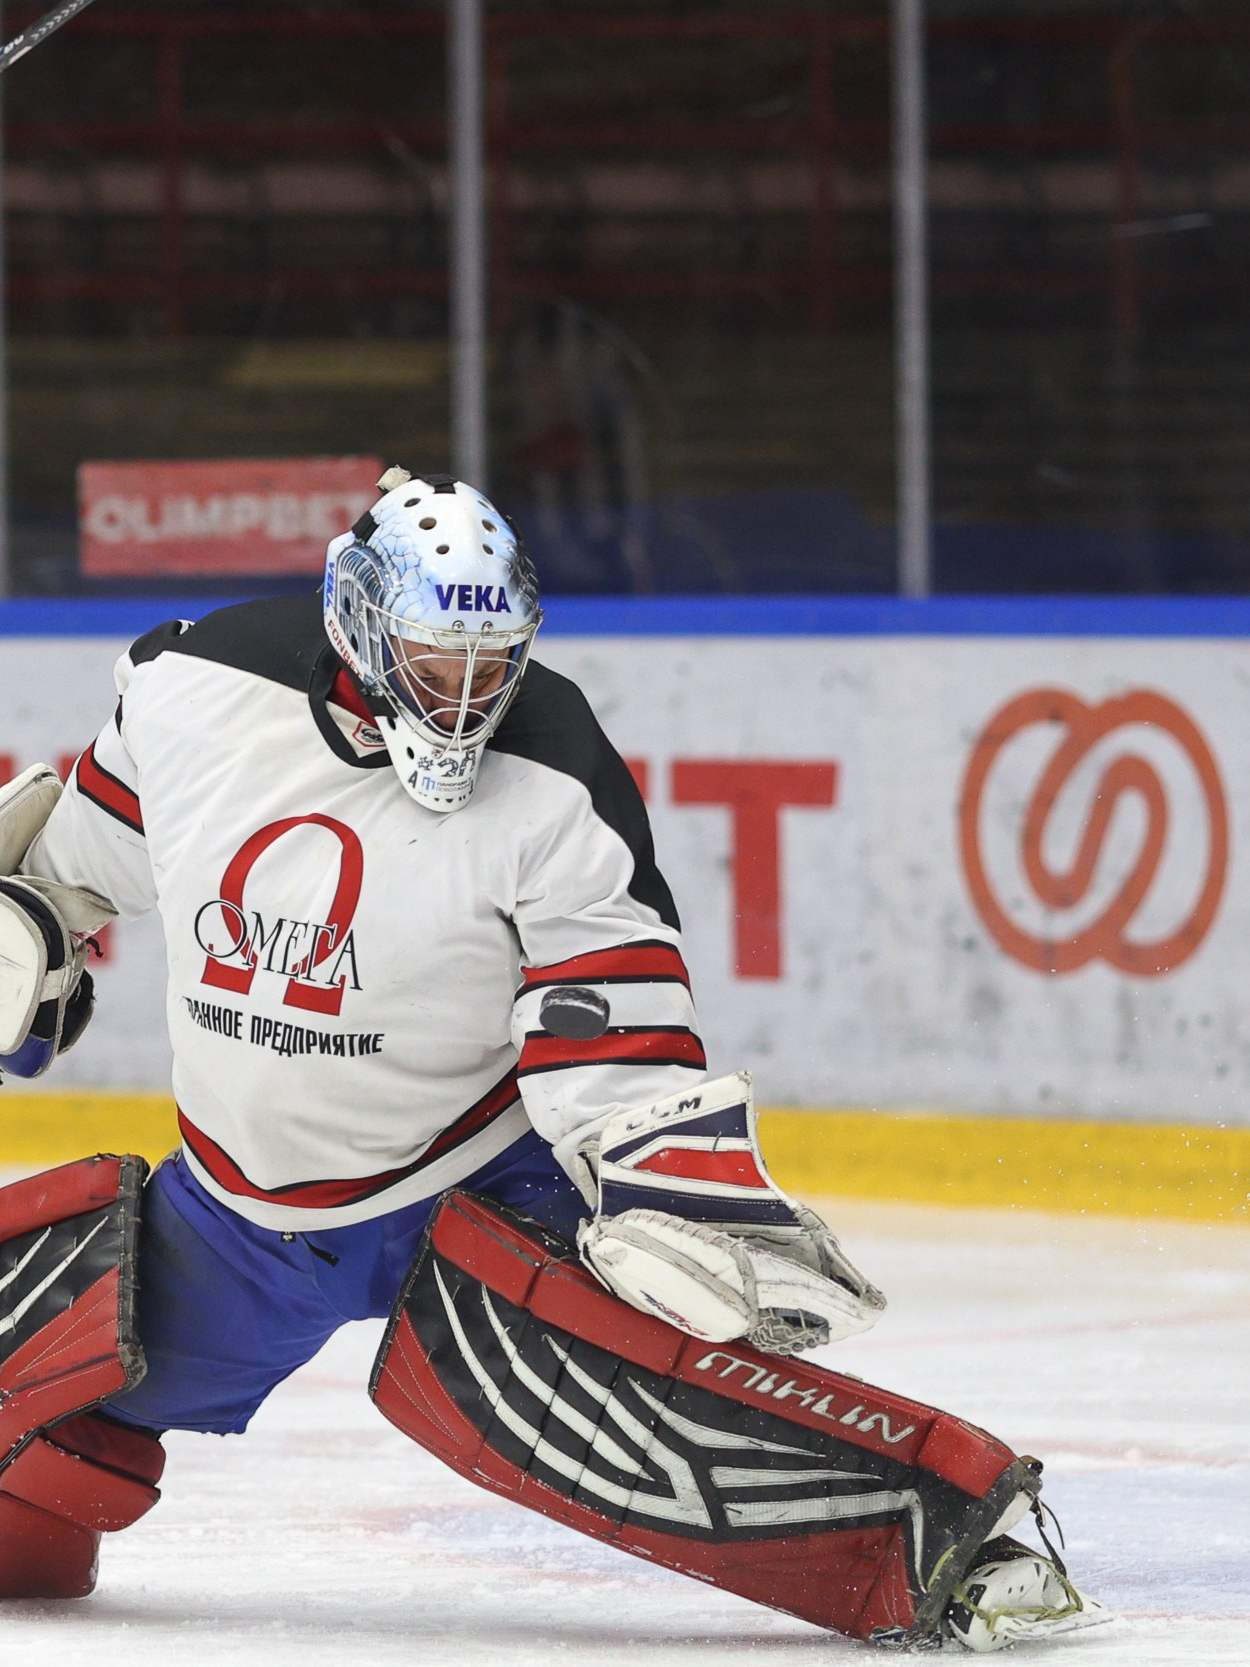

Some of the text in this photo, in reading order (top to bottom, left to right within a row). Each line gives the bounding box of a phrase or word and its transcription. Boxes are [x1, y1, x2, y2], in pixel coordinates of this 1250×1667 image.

[434, 584, 512, 613] VEKA
[328, 619, 363, 678] FONBET
[194, 900, 362, 991] ОМЕГА
[250, 1014, 385, 1058] ПРЕДПРИЯТИЕ
